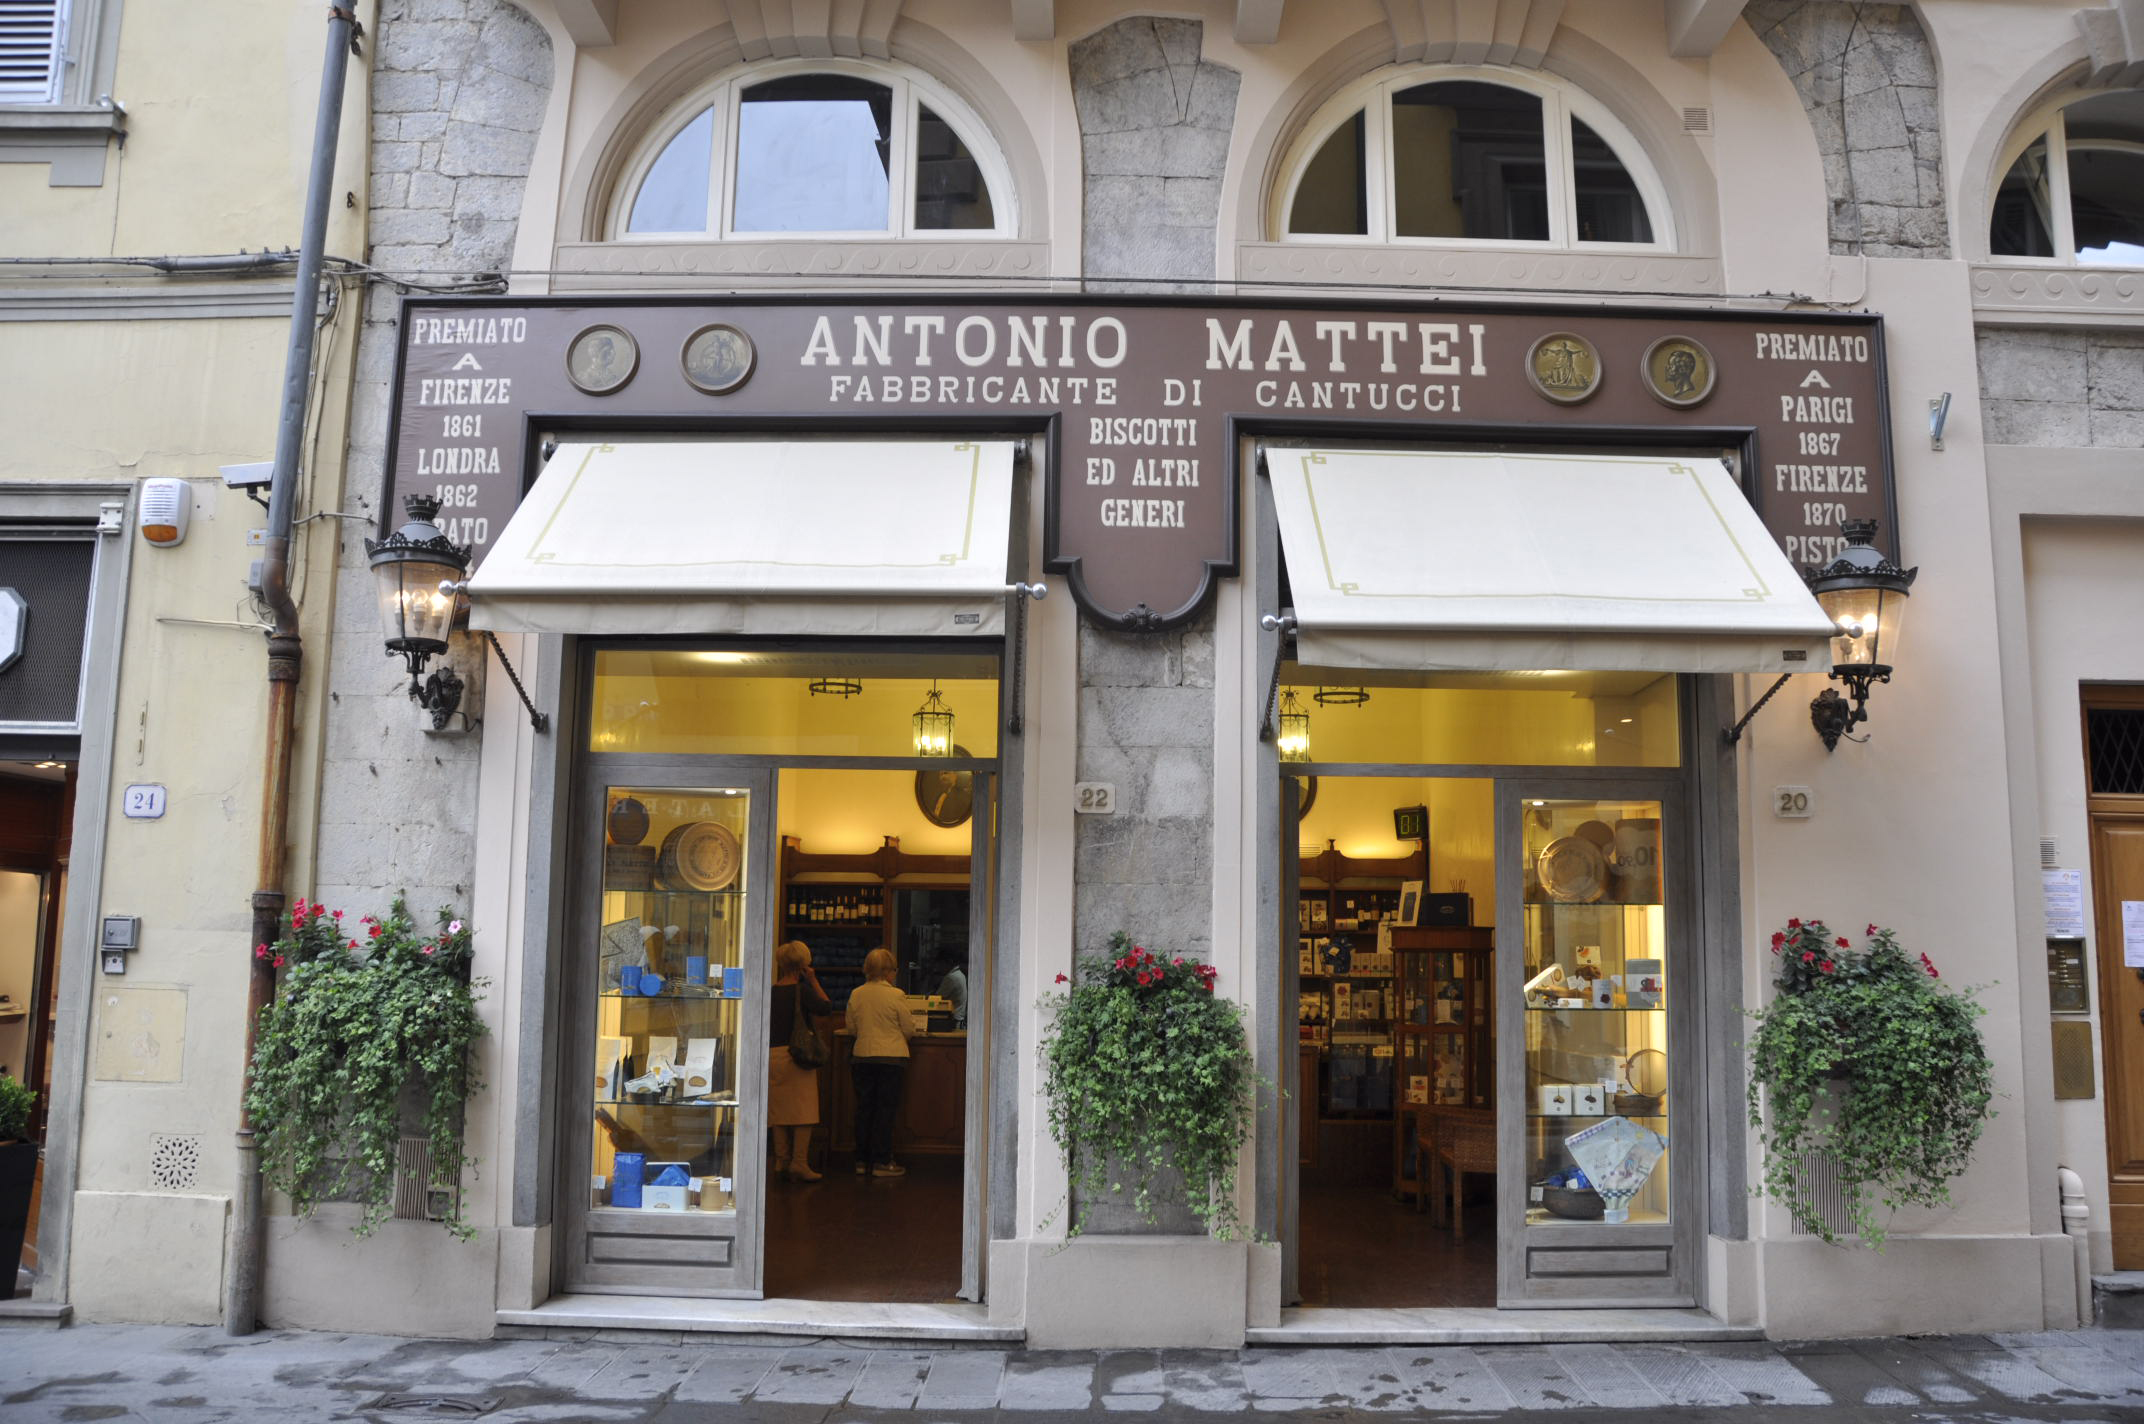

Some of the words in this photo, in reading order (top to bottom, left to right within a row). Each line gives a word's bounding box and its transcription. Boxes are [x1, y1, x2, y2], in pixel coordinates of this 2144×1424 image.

[413, 317, 527, 345] PREMIATO
[800, 315, 1128, 369] ANTONIO
[1205, 317, 1488, 377] MATTEI
[1755, 332, 1868, 363] PREMIATO
[452, 352, 482, 371] A
[419, 378, 511, 406] FIRENZE
[1799, 369, 1830, 389] A
[829, 375, 1117, 406] FABBRICANTE
[1163, 378, 1202, 407] DI
[1255, 379, 1462, 413] CANTUCCI
[1780, 395, 1854, 424] PARIGI
[442, 414, 482, 438] 1861
[1089, 417, 1198, 447] BISCOTTI
[1799, 431, 1841, 456] 1867
[417, 447, 501, 475] LONDRA
[1086, 457, 1116, 487] ED
[1131, 458, 1200, 488] ALTRI
[1775, 464, 1868, 494] FIRENZE
[435, 484, 478, 508] 1862
[1100, 498, 1186, 529] GENERI
[1803, 502, 1847, 526] 1870
[433, 517, 489, 545] RATO
[134, 792, 155, 810] 24
[1081, 788, 1108, 807] 22
[1780, 792, 1808, 811] 20
